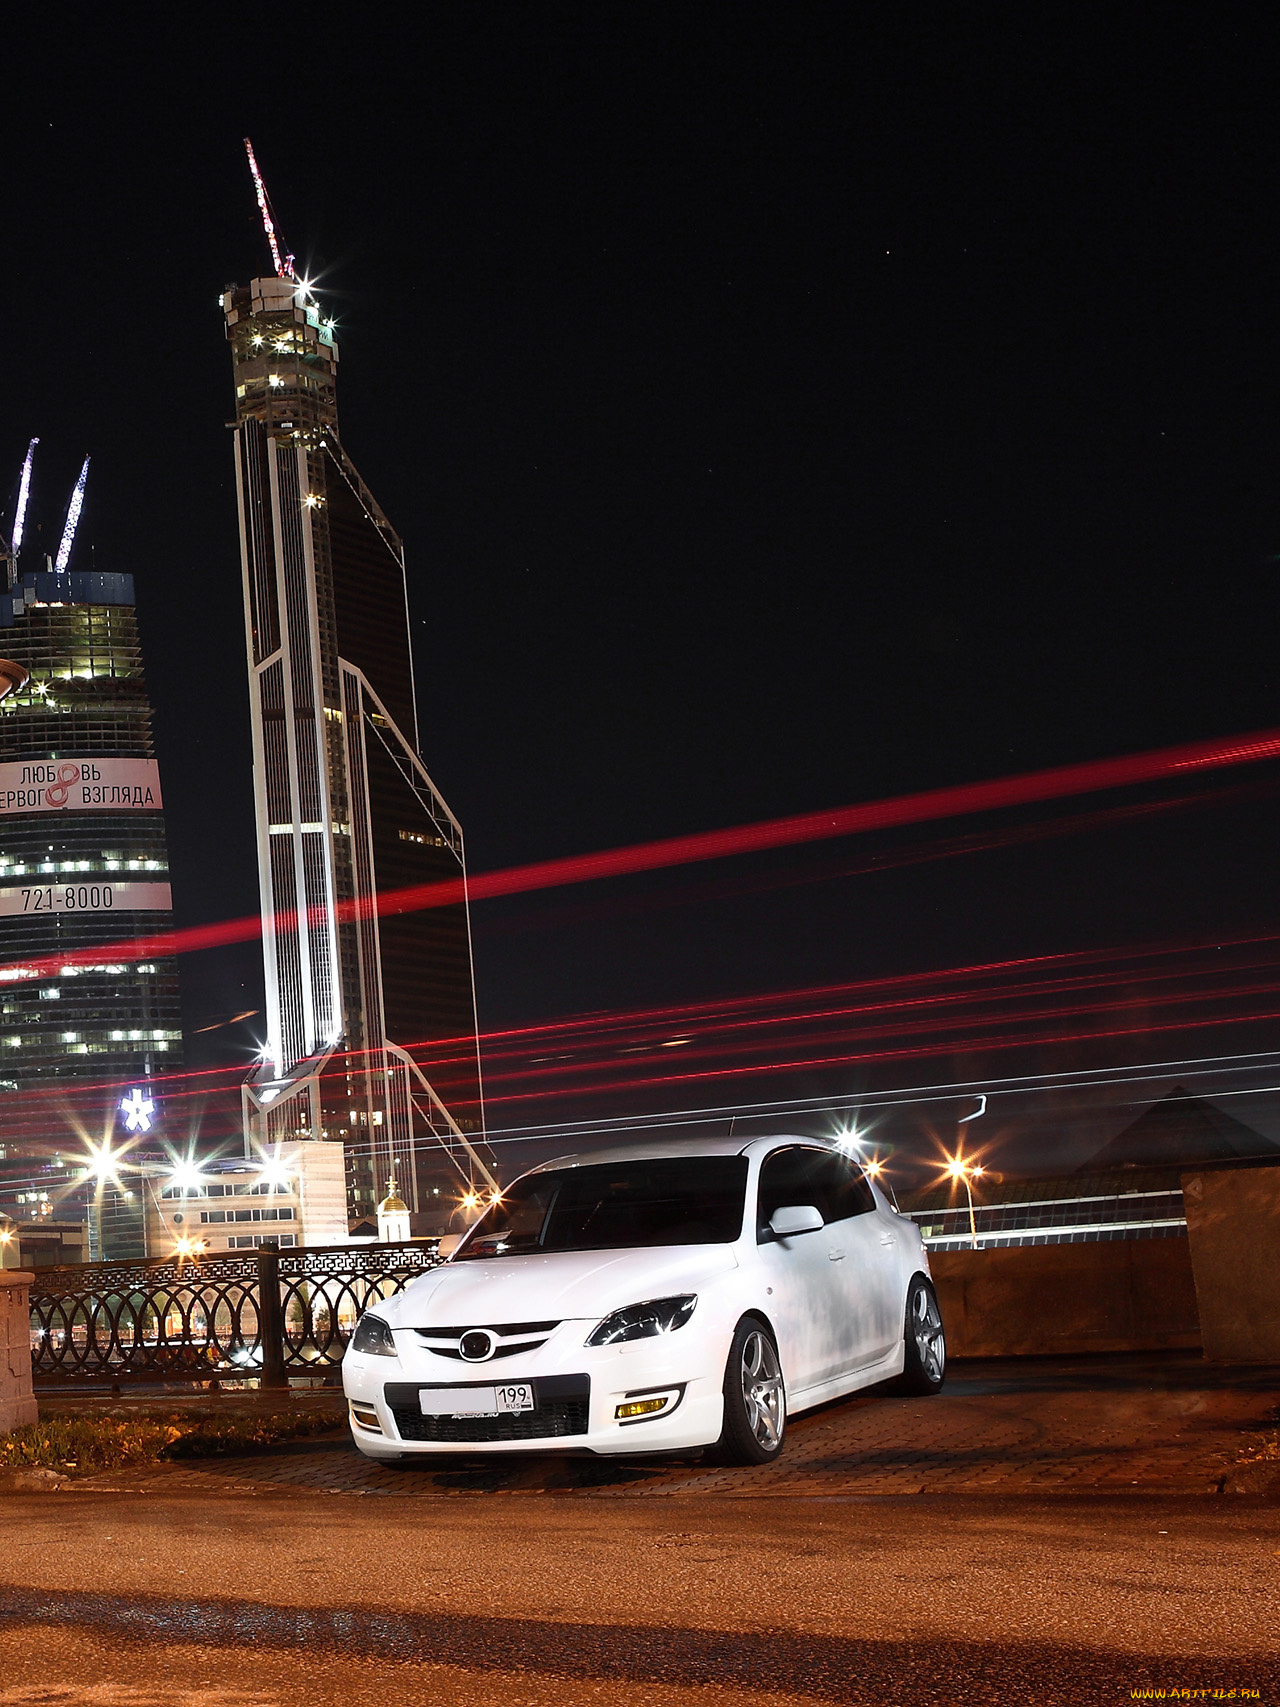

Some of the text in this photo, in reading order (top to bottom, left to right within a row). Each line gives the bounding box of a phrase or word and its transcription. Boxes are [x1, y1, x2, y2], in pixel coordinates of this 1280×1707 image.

[82, 786, 155, 807] ВЗГЛЯДА
[21, 886, 113, 911] 721-8000
[498, 1387, 526, 1403] 199
